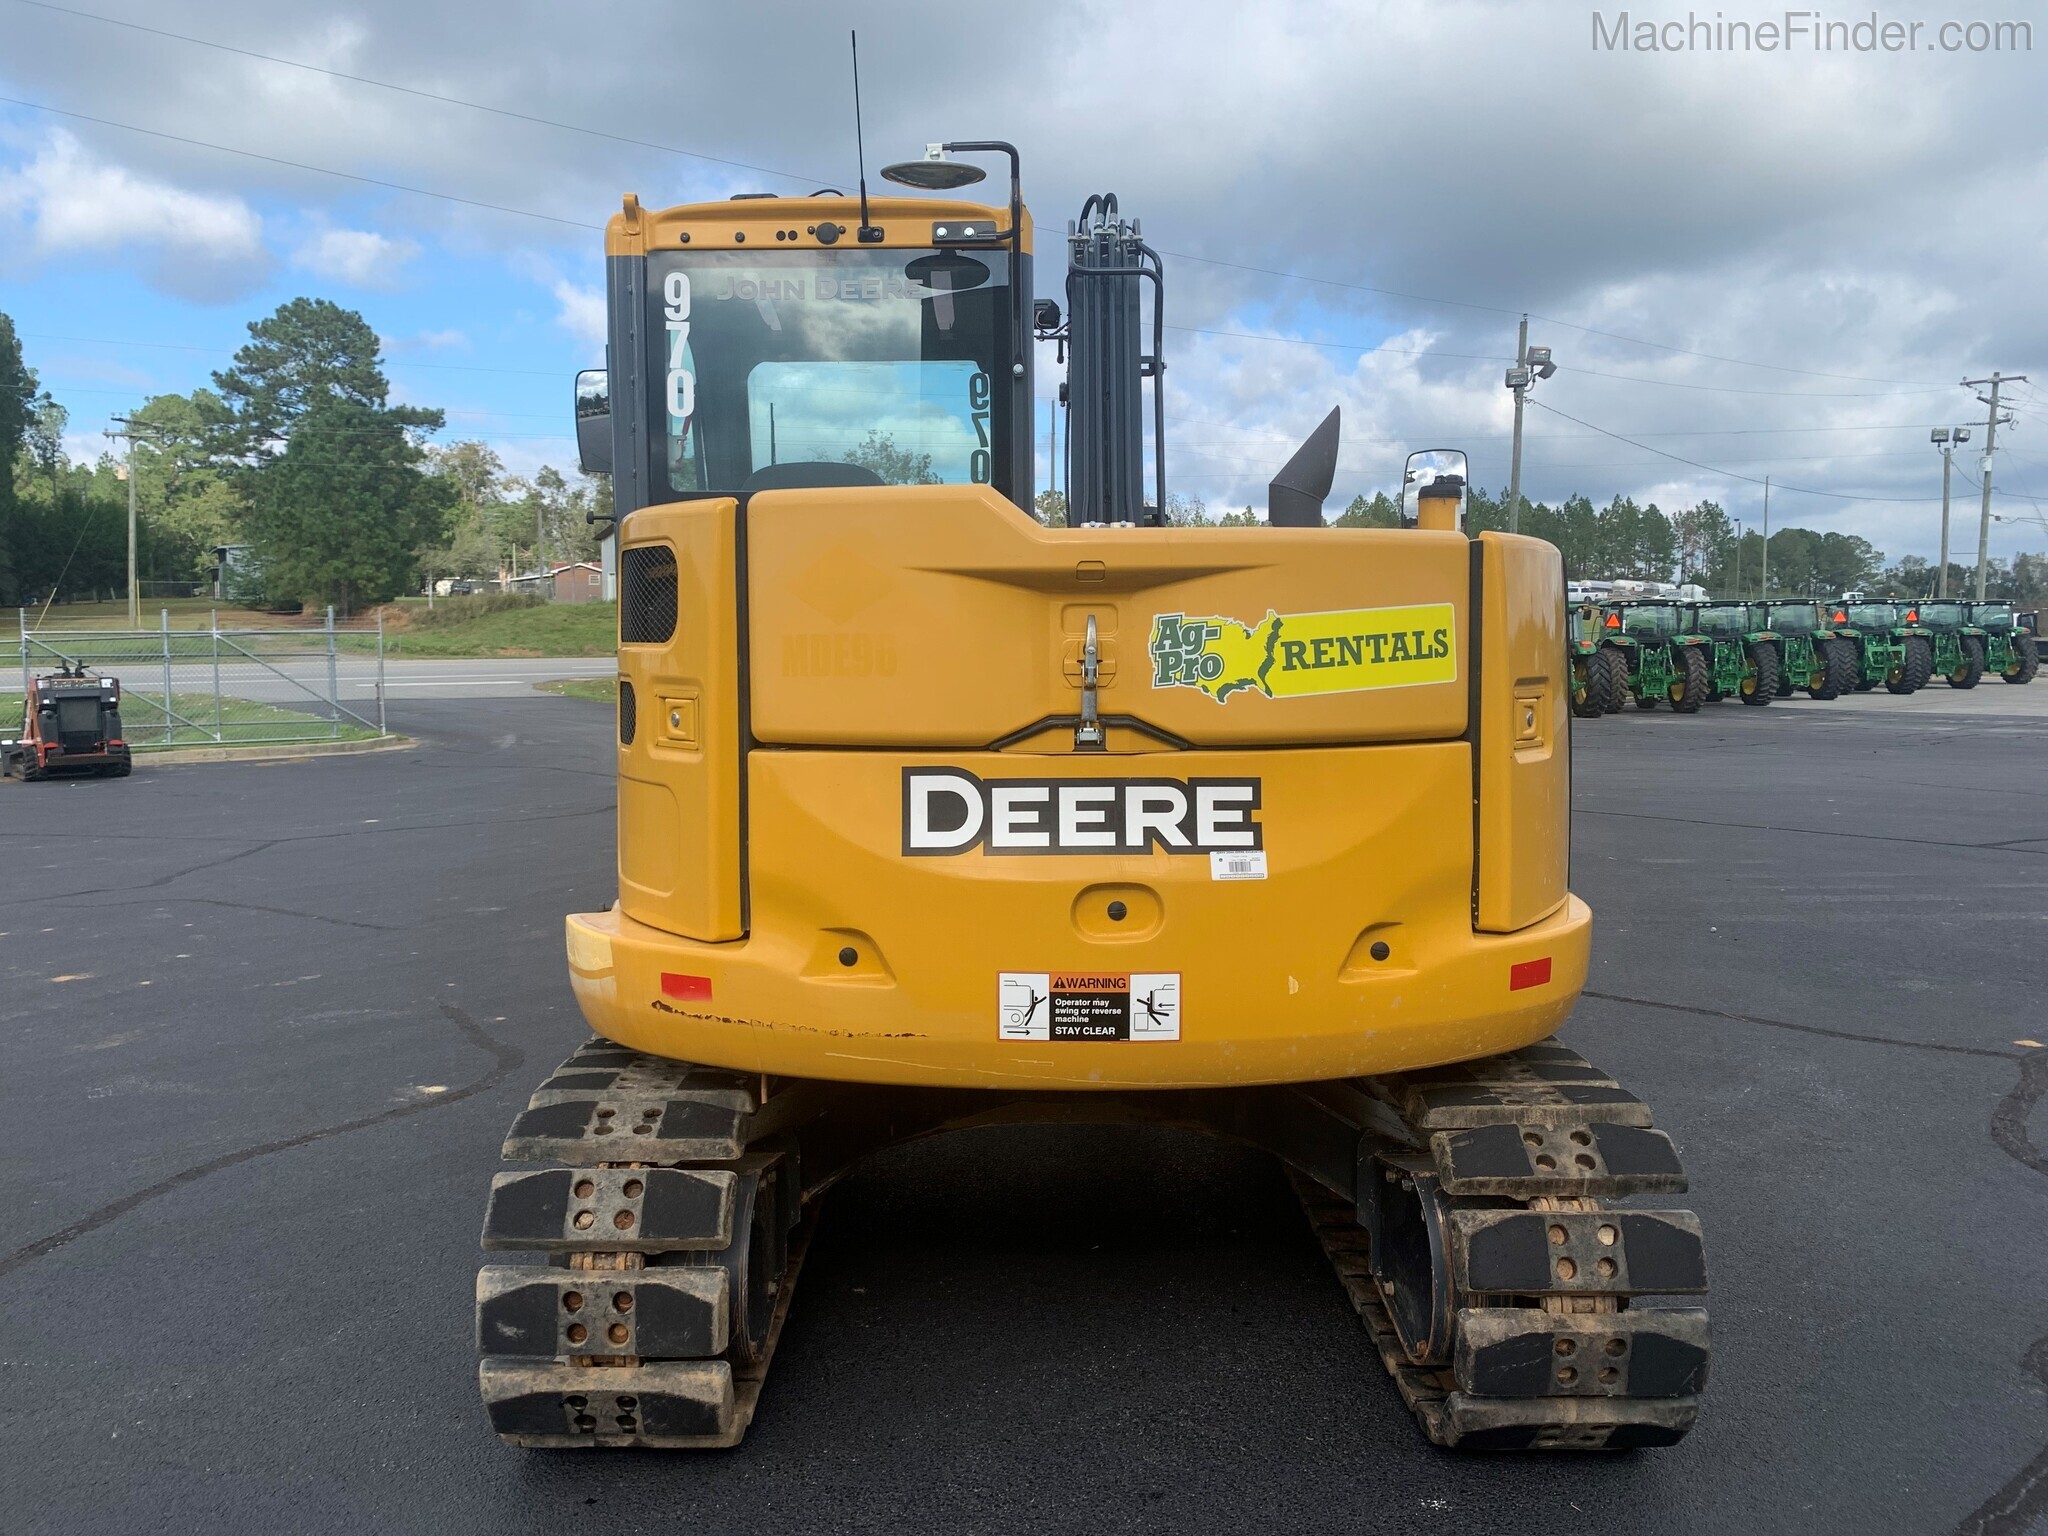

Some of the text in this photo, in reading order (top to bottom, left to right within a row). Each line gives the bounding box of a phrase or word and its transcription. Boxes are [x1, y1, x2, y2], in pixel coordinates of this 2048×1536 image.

[717, 276, 924, 300] JOHN DEERE
[663, 272, 695, 417] 970
[1154, 615, 1221, 653] Ag-
[1280, 628, 1449, 672] RENTALS
[1154, 651, 1224, 686] Pro
[909, 774, 1255, 848] DEERE
[1066, 977, 1127, 989] WARNING
[1055, 999, 1110, 1008] Operator may
[1055, 1008, 1080, 1017] swing
[1055, 1026, 1116, 1035] STAY CLEAR
